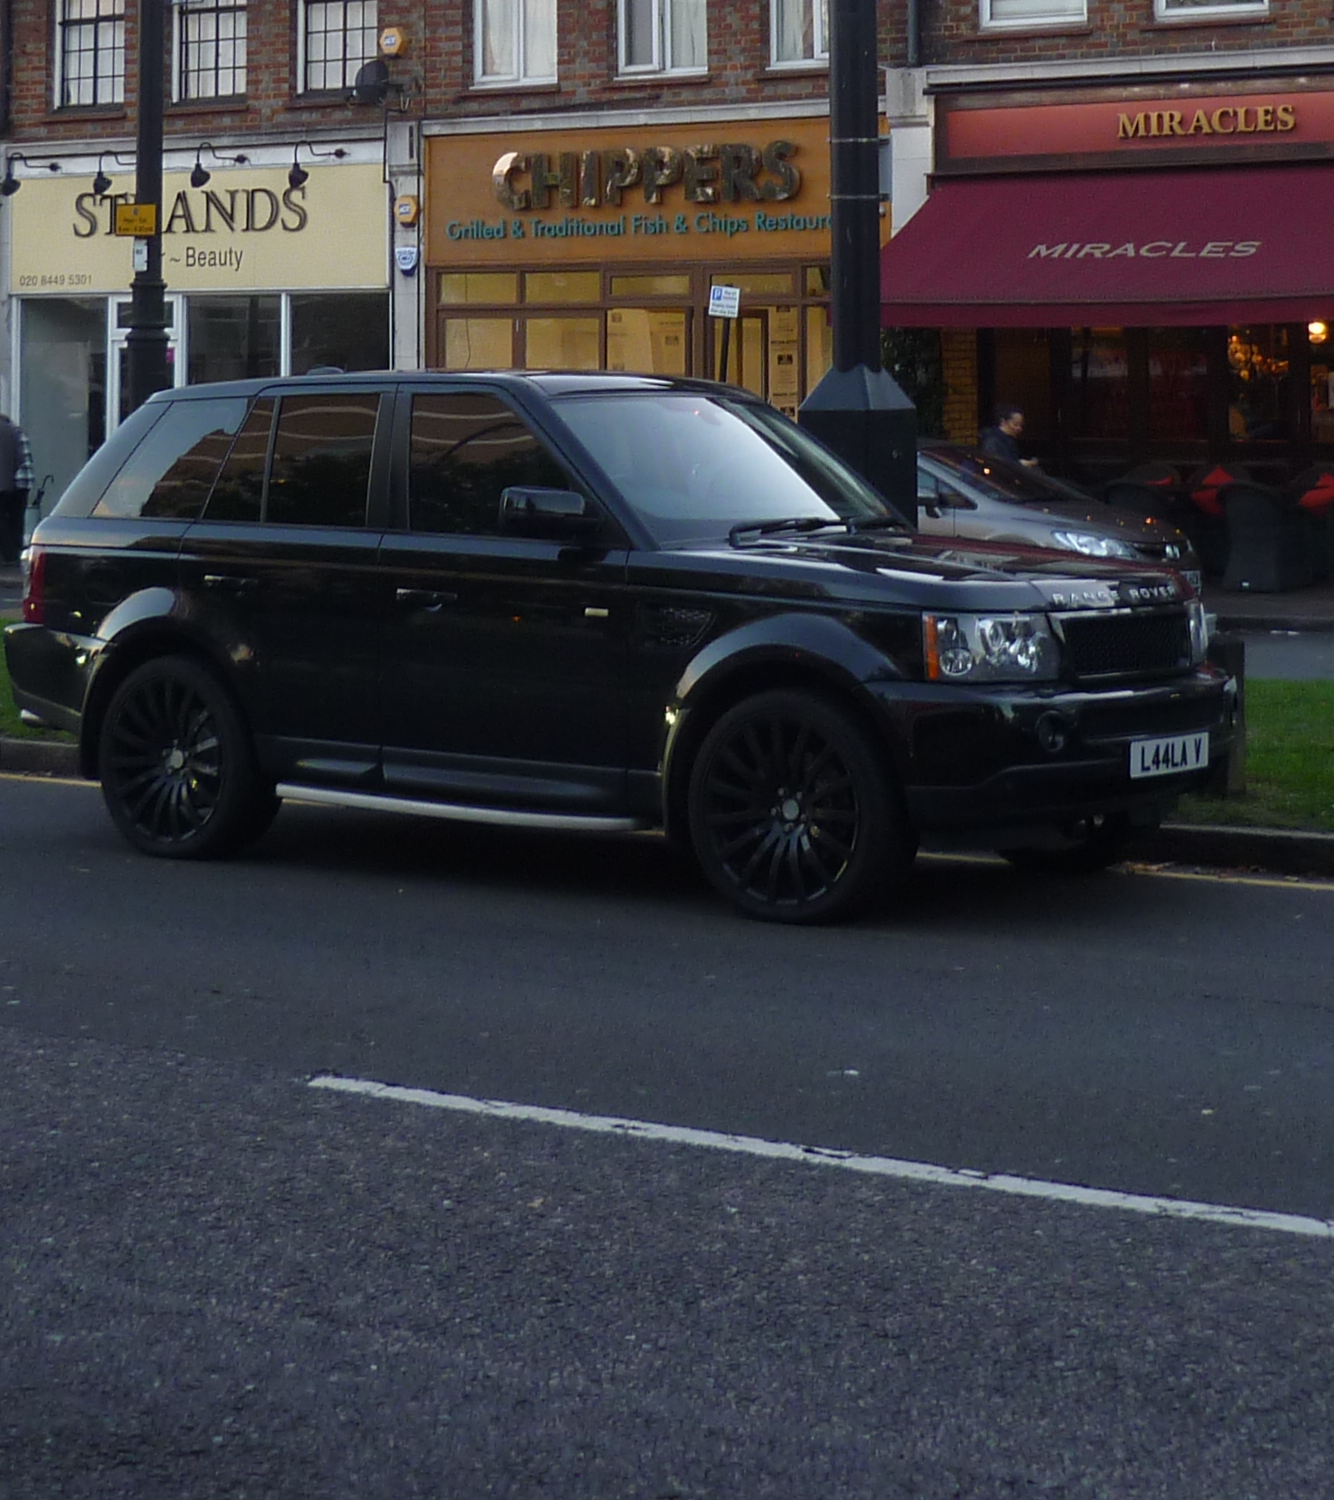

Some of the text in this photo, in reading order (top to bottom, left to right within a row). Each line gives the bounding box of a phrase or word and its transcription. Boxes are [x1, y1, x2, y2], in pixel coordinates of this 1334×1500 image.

[1117, 104, 1297, 139] MIRACLES
[492, 140, 803, 211] CHIPPERS
[72, 187, 309, 238] STANDS
[445, 210, 832, 241] Grilled & Traditional Fish & Chips Restaur
[185, 246, 243, 271] Beauty
[1027, 240, 1262, 258] MIRACLES
[20, 273, 92, 286] 020 8449 5301
[1052, 584, 1177, 605] RANGE ROVER
[1140, 741, 1188, 773] L44LA
